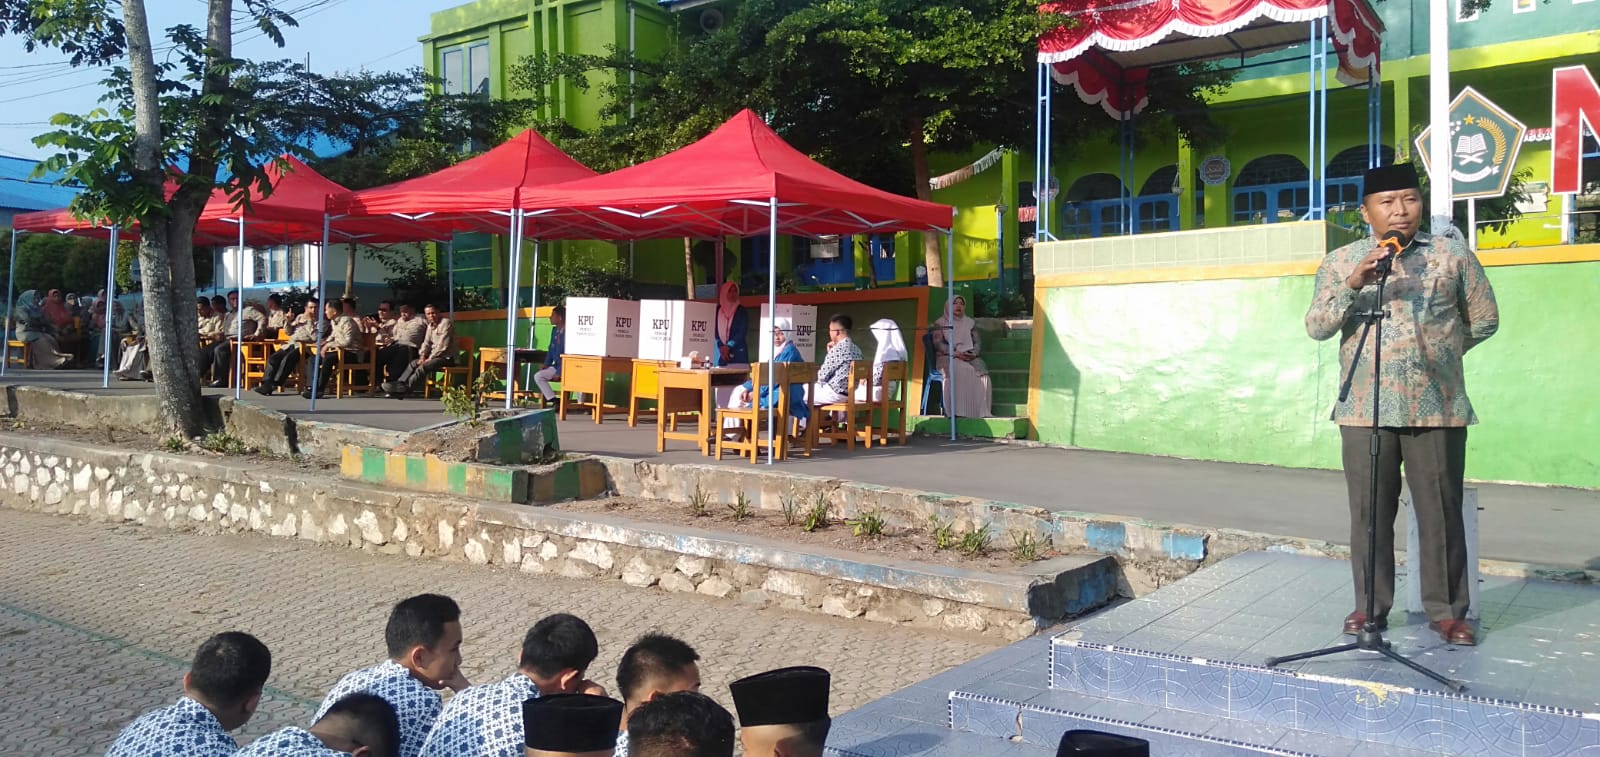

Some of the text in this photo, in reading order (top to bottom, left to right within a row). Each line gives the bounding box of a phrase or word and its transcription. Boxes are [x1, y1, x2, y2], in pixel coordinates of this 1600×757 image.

[578, 315, 594, 326] KPU
[615, 316, 632, 328] KPU
[652, 318, 670, 330] KPU
[691, 320, 707, 332] KPU
[796, 325, 812, 336] KPU
